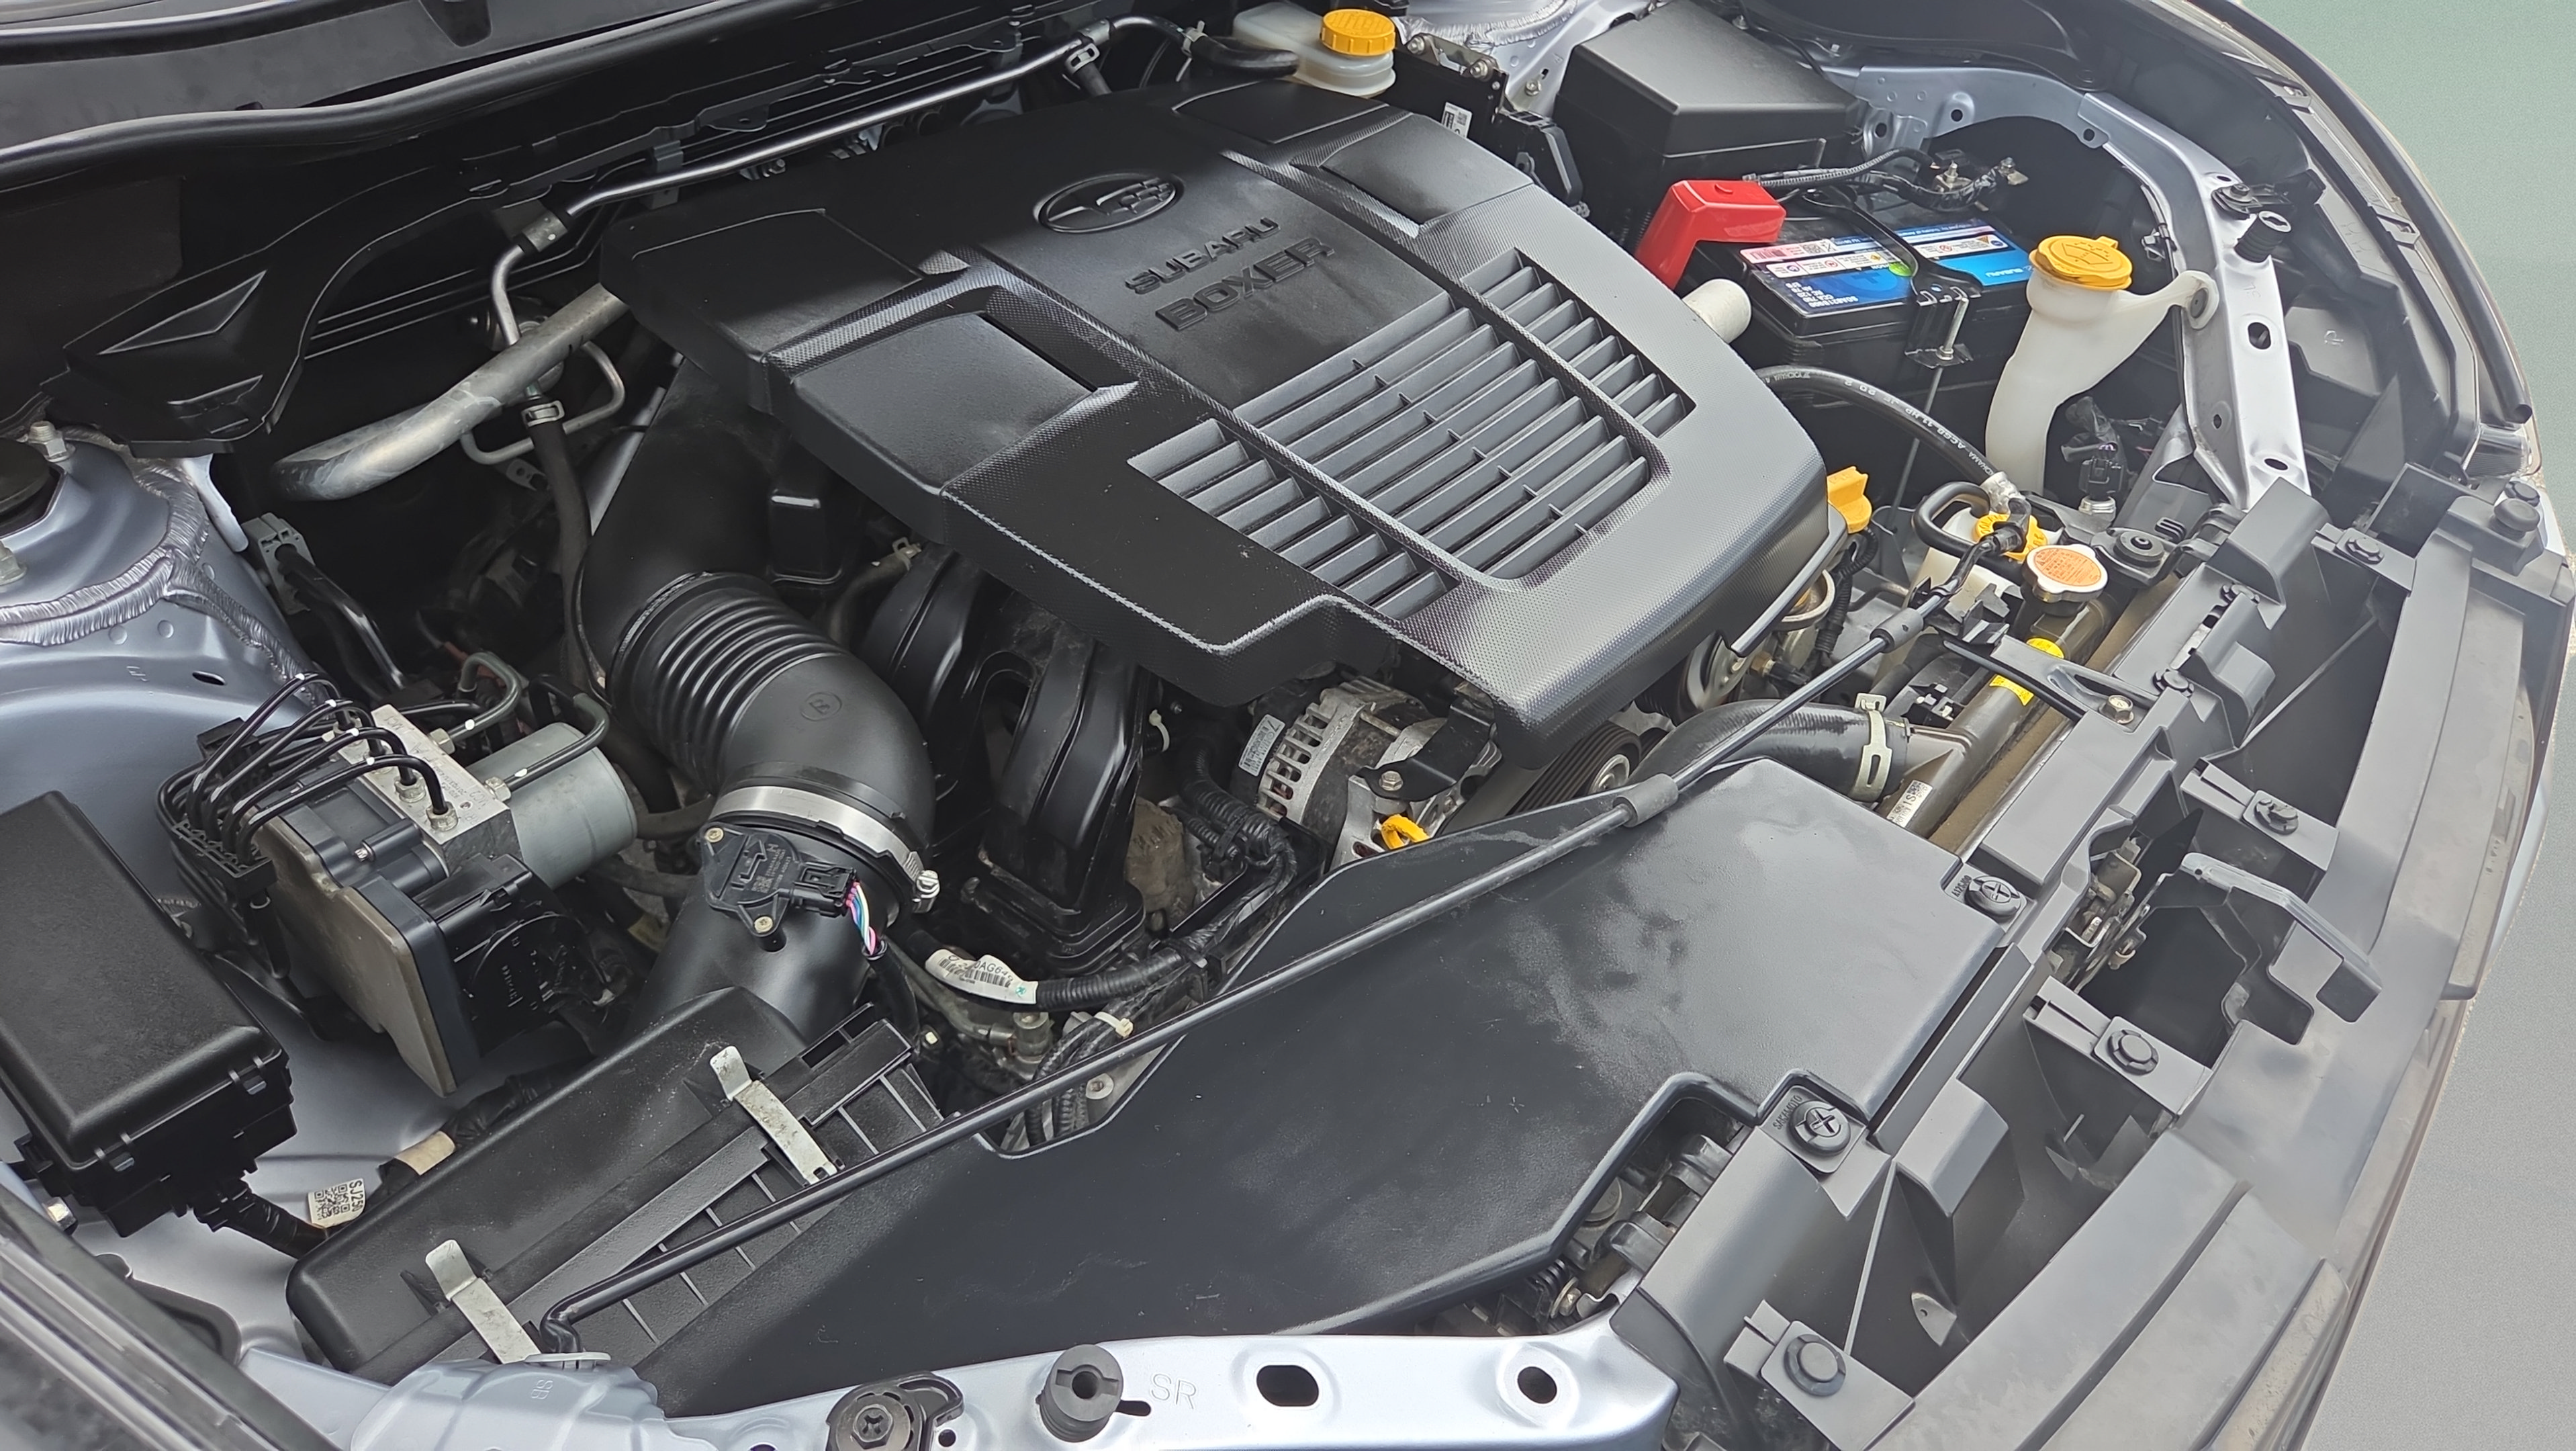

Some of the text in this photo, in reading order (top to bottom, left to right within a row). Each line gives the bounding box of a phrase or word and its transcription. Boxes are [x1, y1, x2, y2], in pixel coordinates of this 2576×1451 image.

[1125, 217, 1280, 296] SUBARU
[1985, 268, 2023, 278] SUBARU
[1155, 238, 1336, 331] BOXER
[1773, 1094, 1802, 1130] SAKAMOTO
[1151, 1373, 1197, 1410] SR
